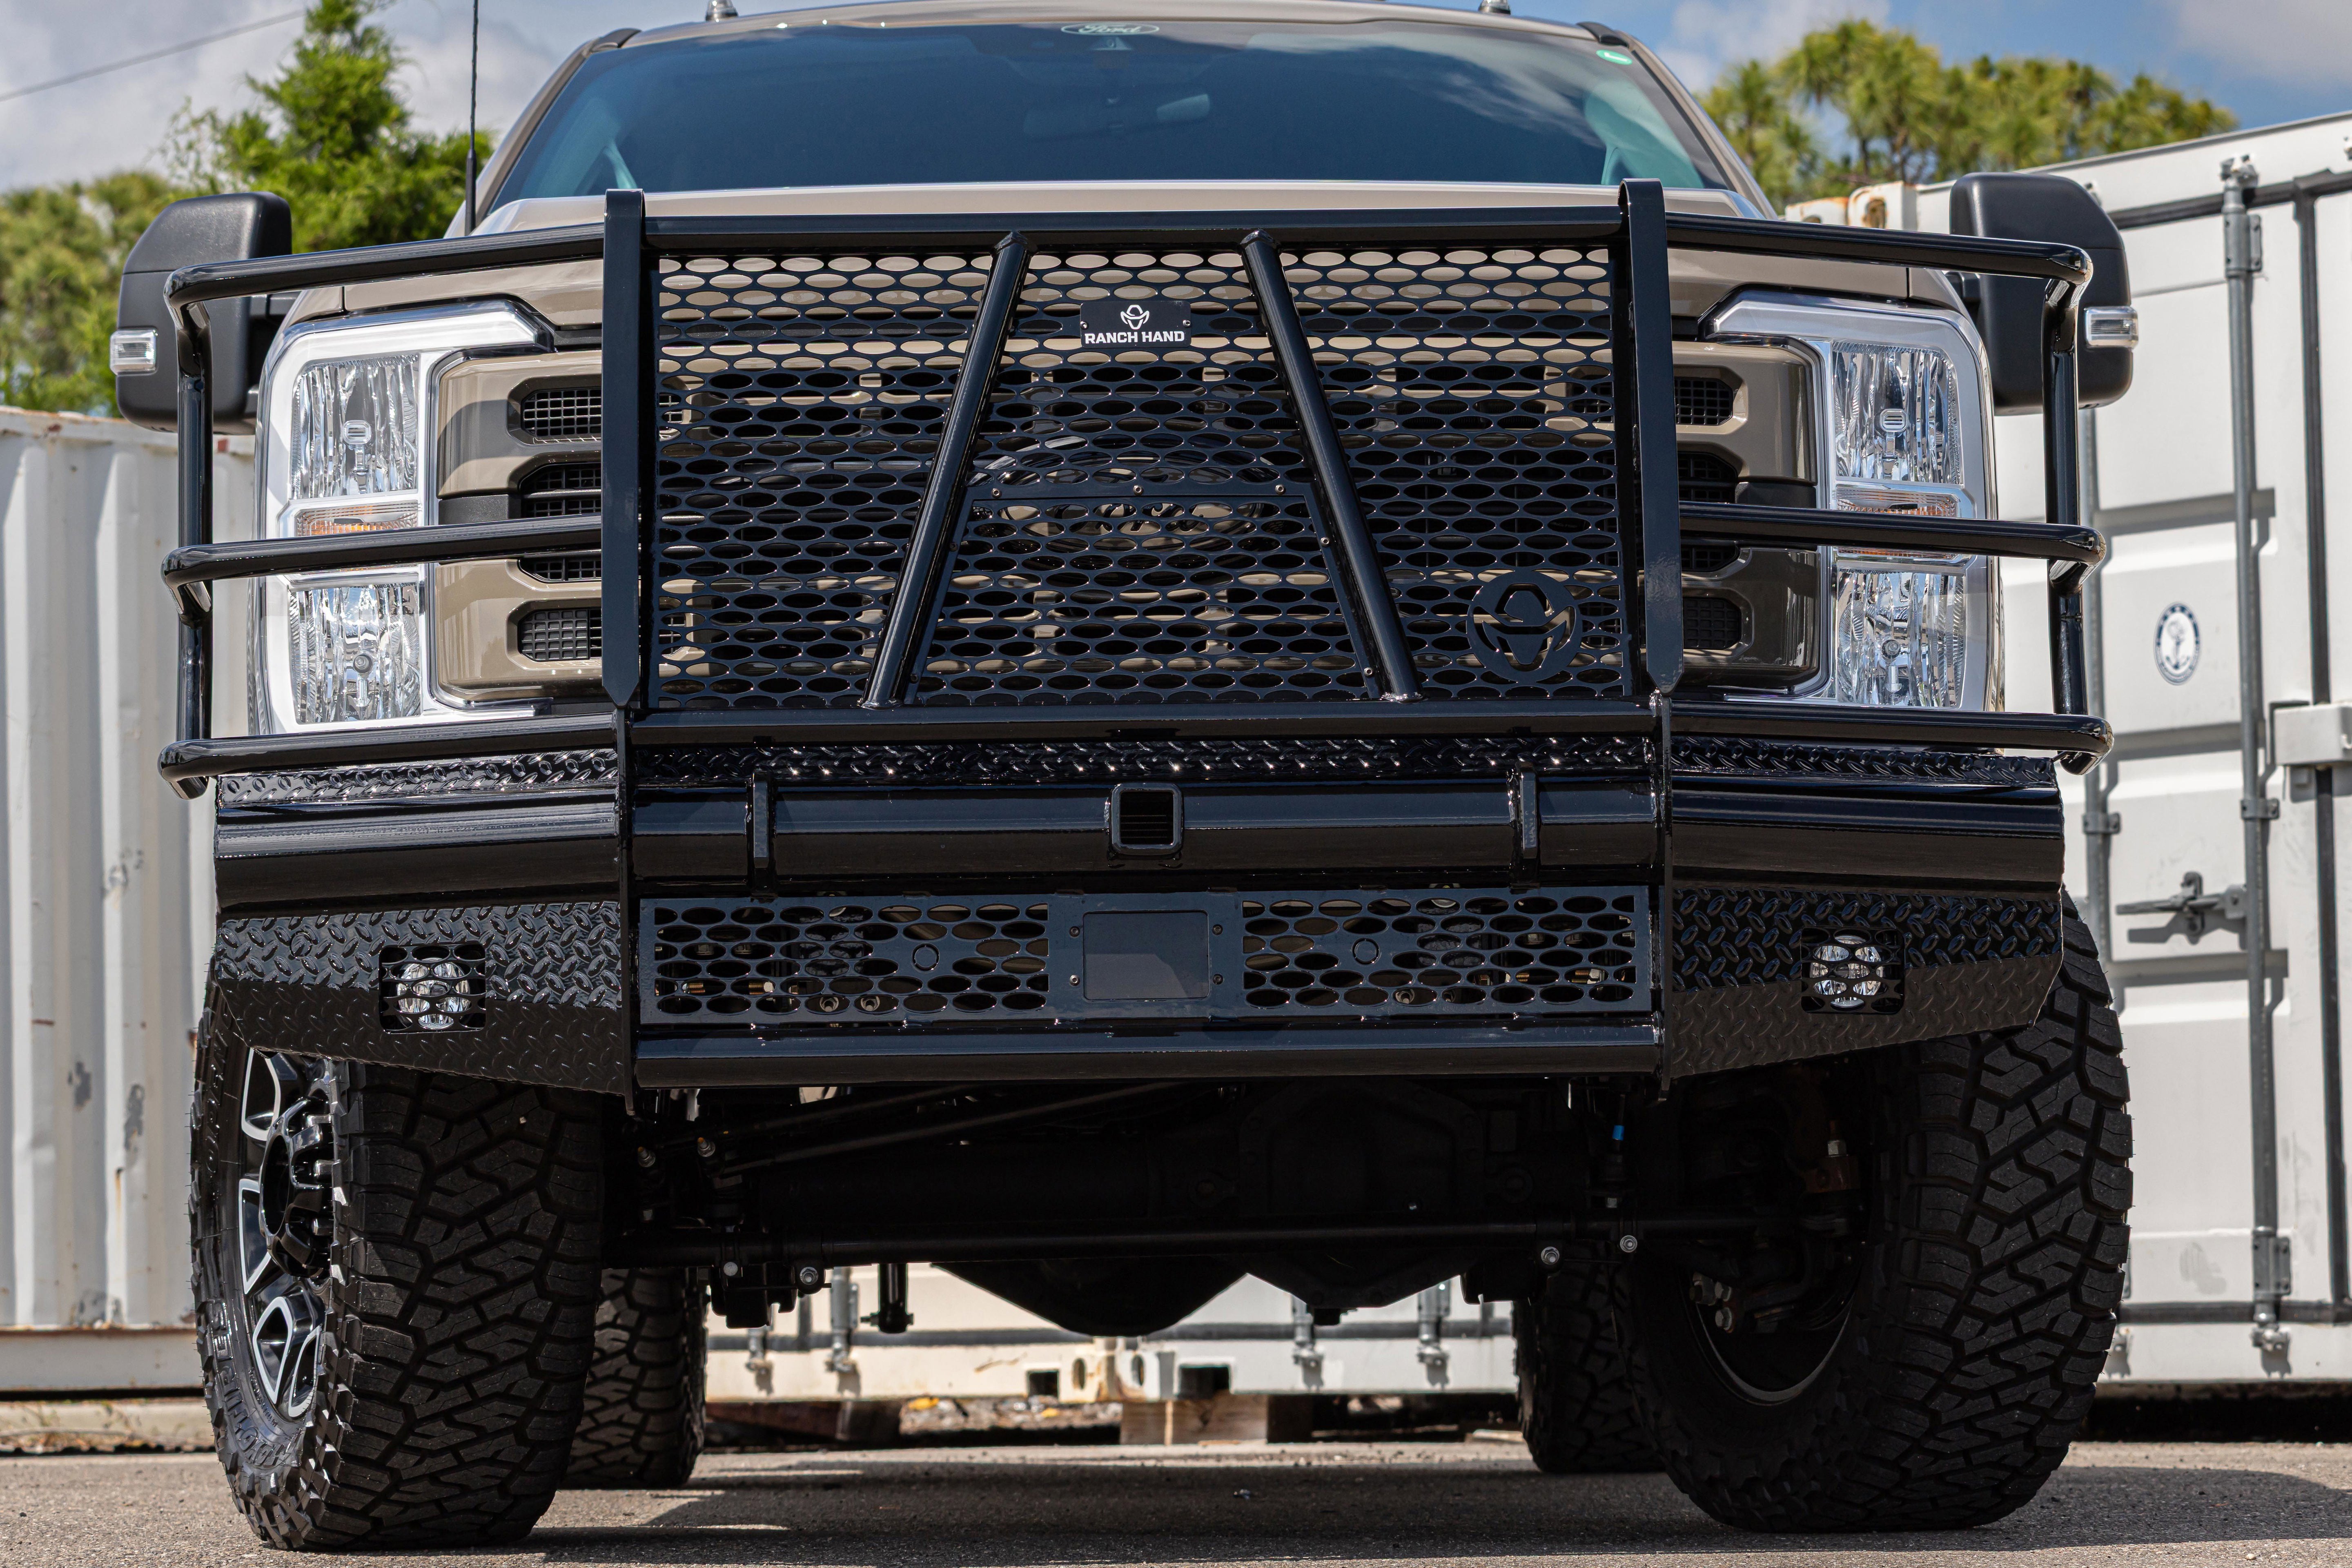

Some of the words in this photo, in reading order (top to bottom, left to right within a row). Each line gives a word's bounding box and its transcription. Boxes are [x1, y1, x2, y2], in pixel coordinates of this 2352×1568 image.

[1078, 24, 1142, 33] Ford
[1085, 332, 1138, 344] RANCH
[1141, 331, 1185, 343] HAND
[209, 1301, 249, 1433] TIRES
